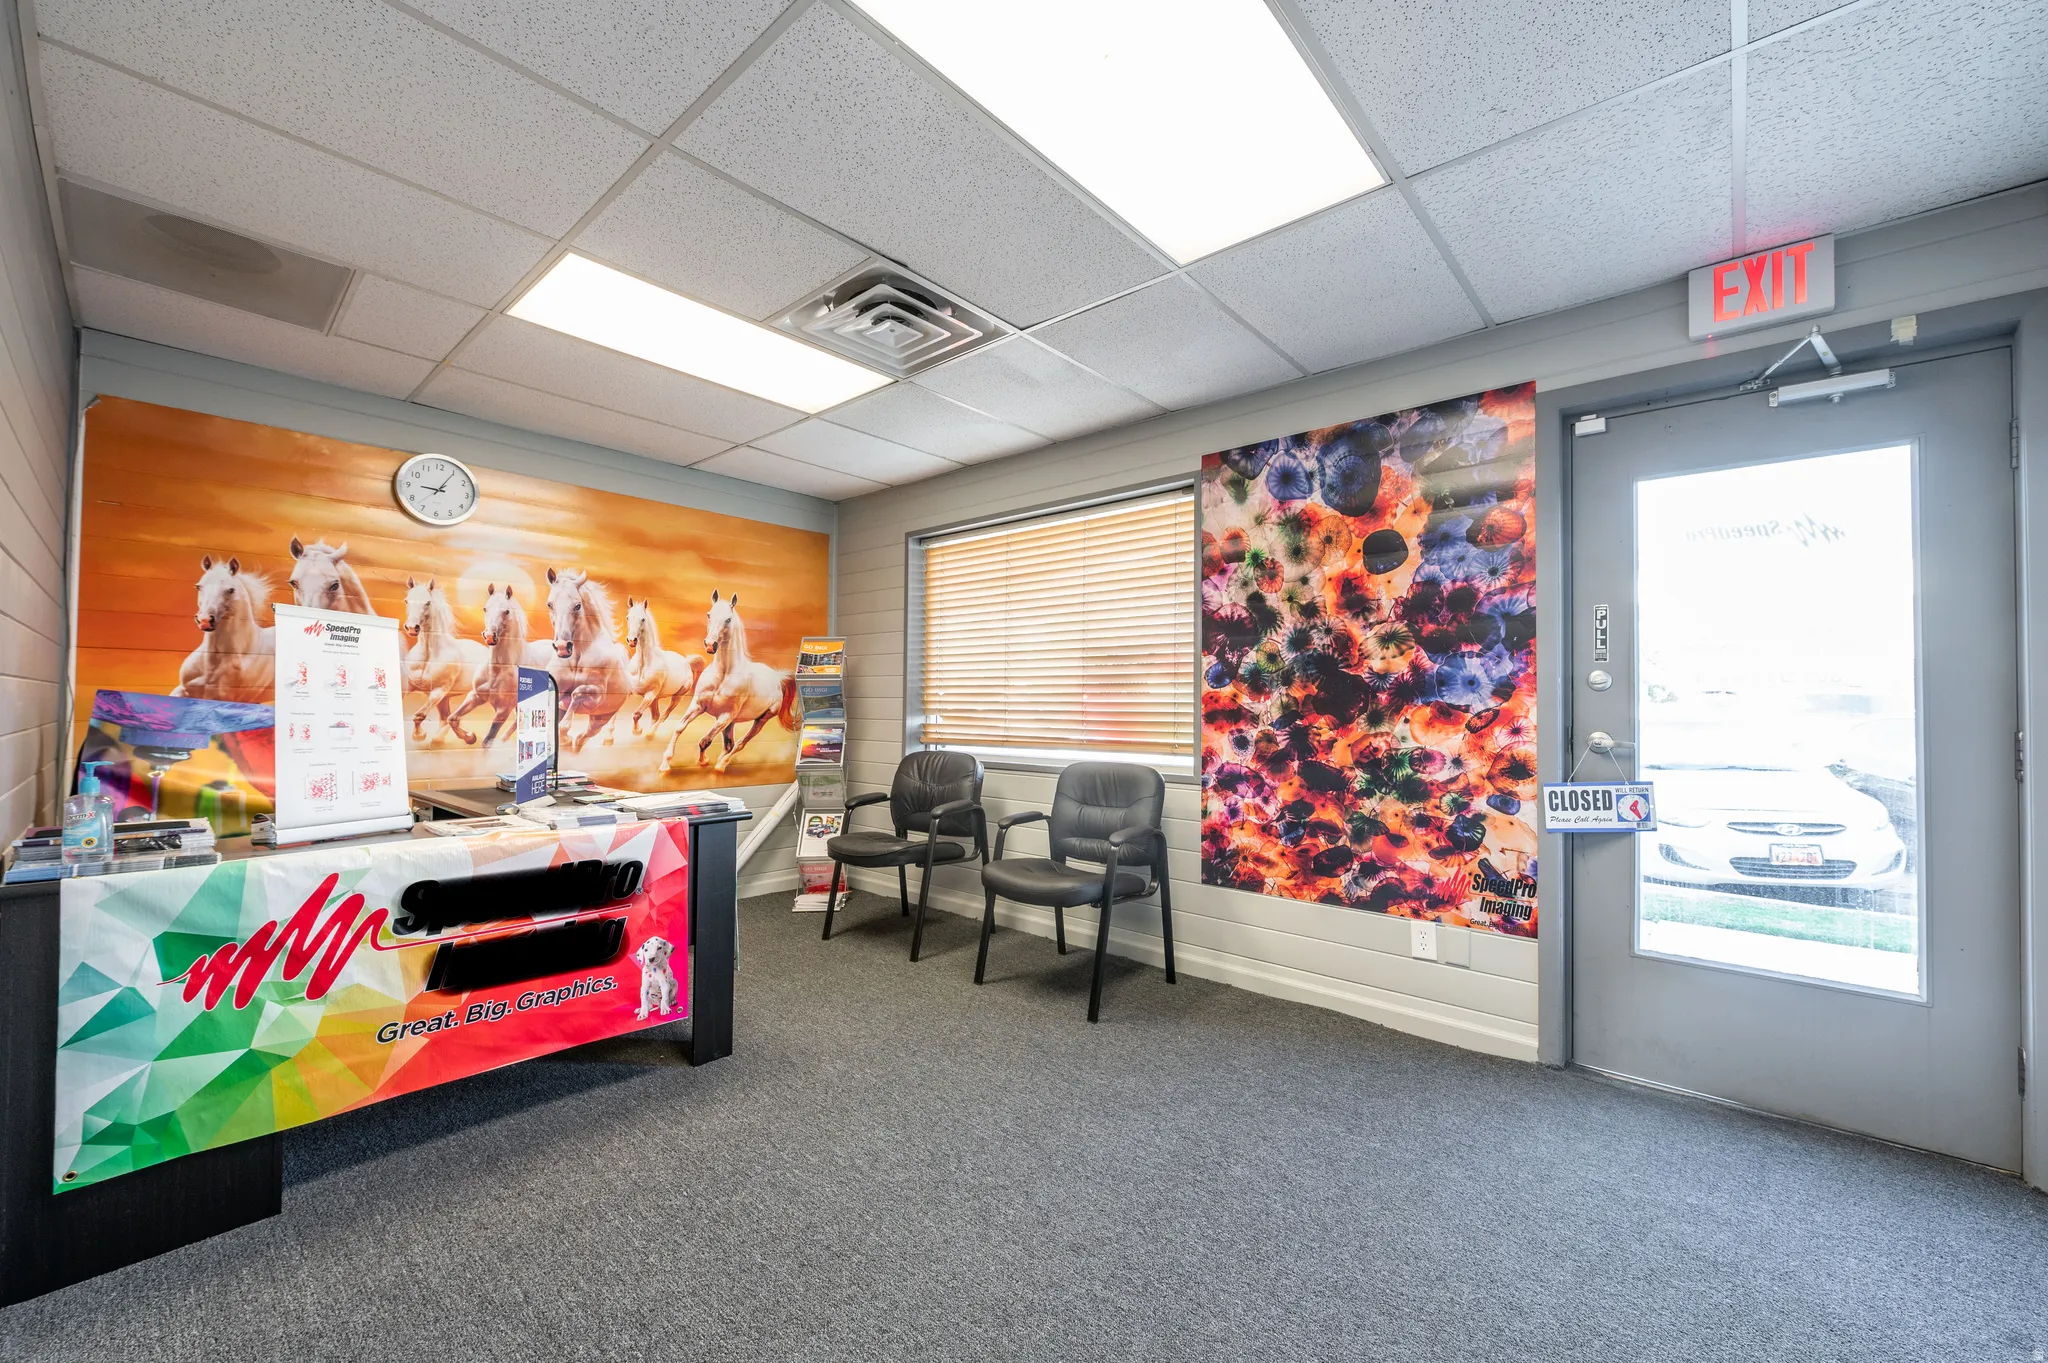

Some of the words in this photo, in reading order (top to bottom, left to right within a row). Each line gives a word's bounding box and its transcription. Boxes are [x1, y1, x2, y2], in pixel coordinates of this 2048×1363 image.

[1713, 242, 1815, 323] EXIT
[422, 464, 431, 472] 11
[435, 463, 445, 472] 12
[411, 471, 421, 479] 10
[461, 479, 466, 487] 2
[420, 504, 426, 512] 7
[447, 509, 453, 517] 5
[325, 623, 362, 635] SpeedPro
[1595, 609, 1607, 649] PULL
[329, 633, 360, 643] Imaging
[531, 780, 545, 795] HERE
[1548, 789, 1613, 812] CLOSED
[1591, 816, 1613, 824] Again
[1471, 873, 1537, 899] SpeedPro
[1479, 896, 1533, 921] Imaging
[377, 1010, 459, 1044] Great.
[465, 1000, 512, 1024] Big.
[516, 975, 618, 1011] Graphics.
